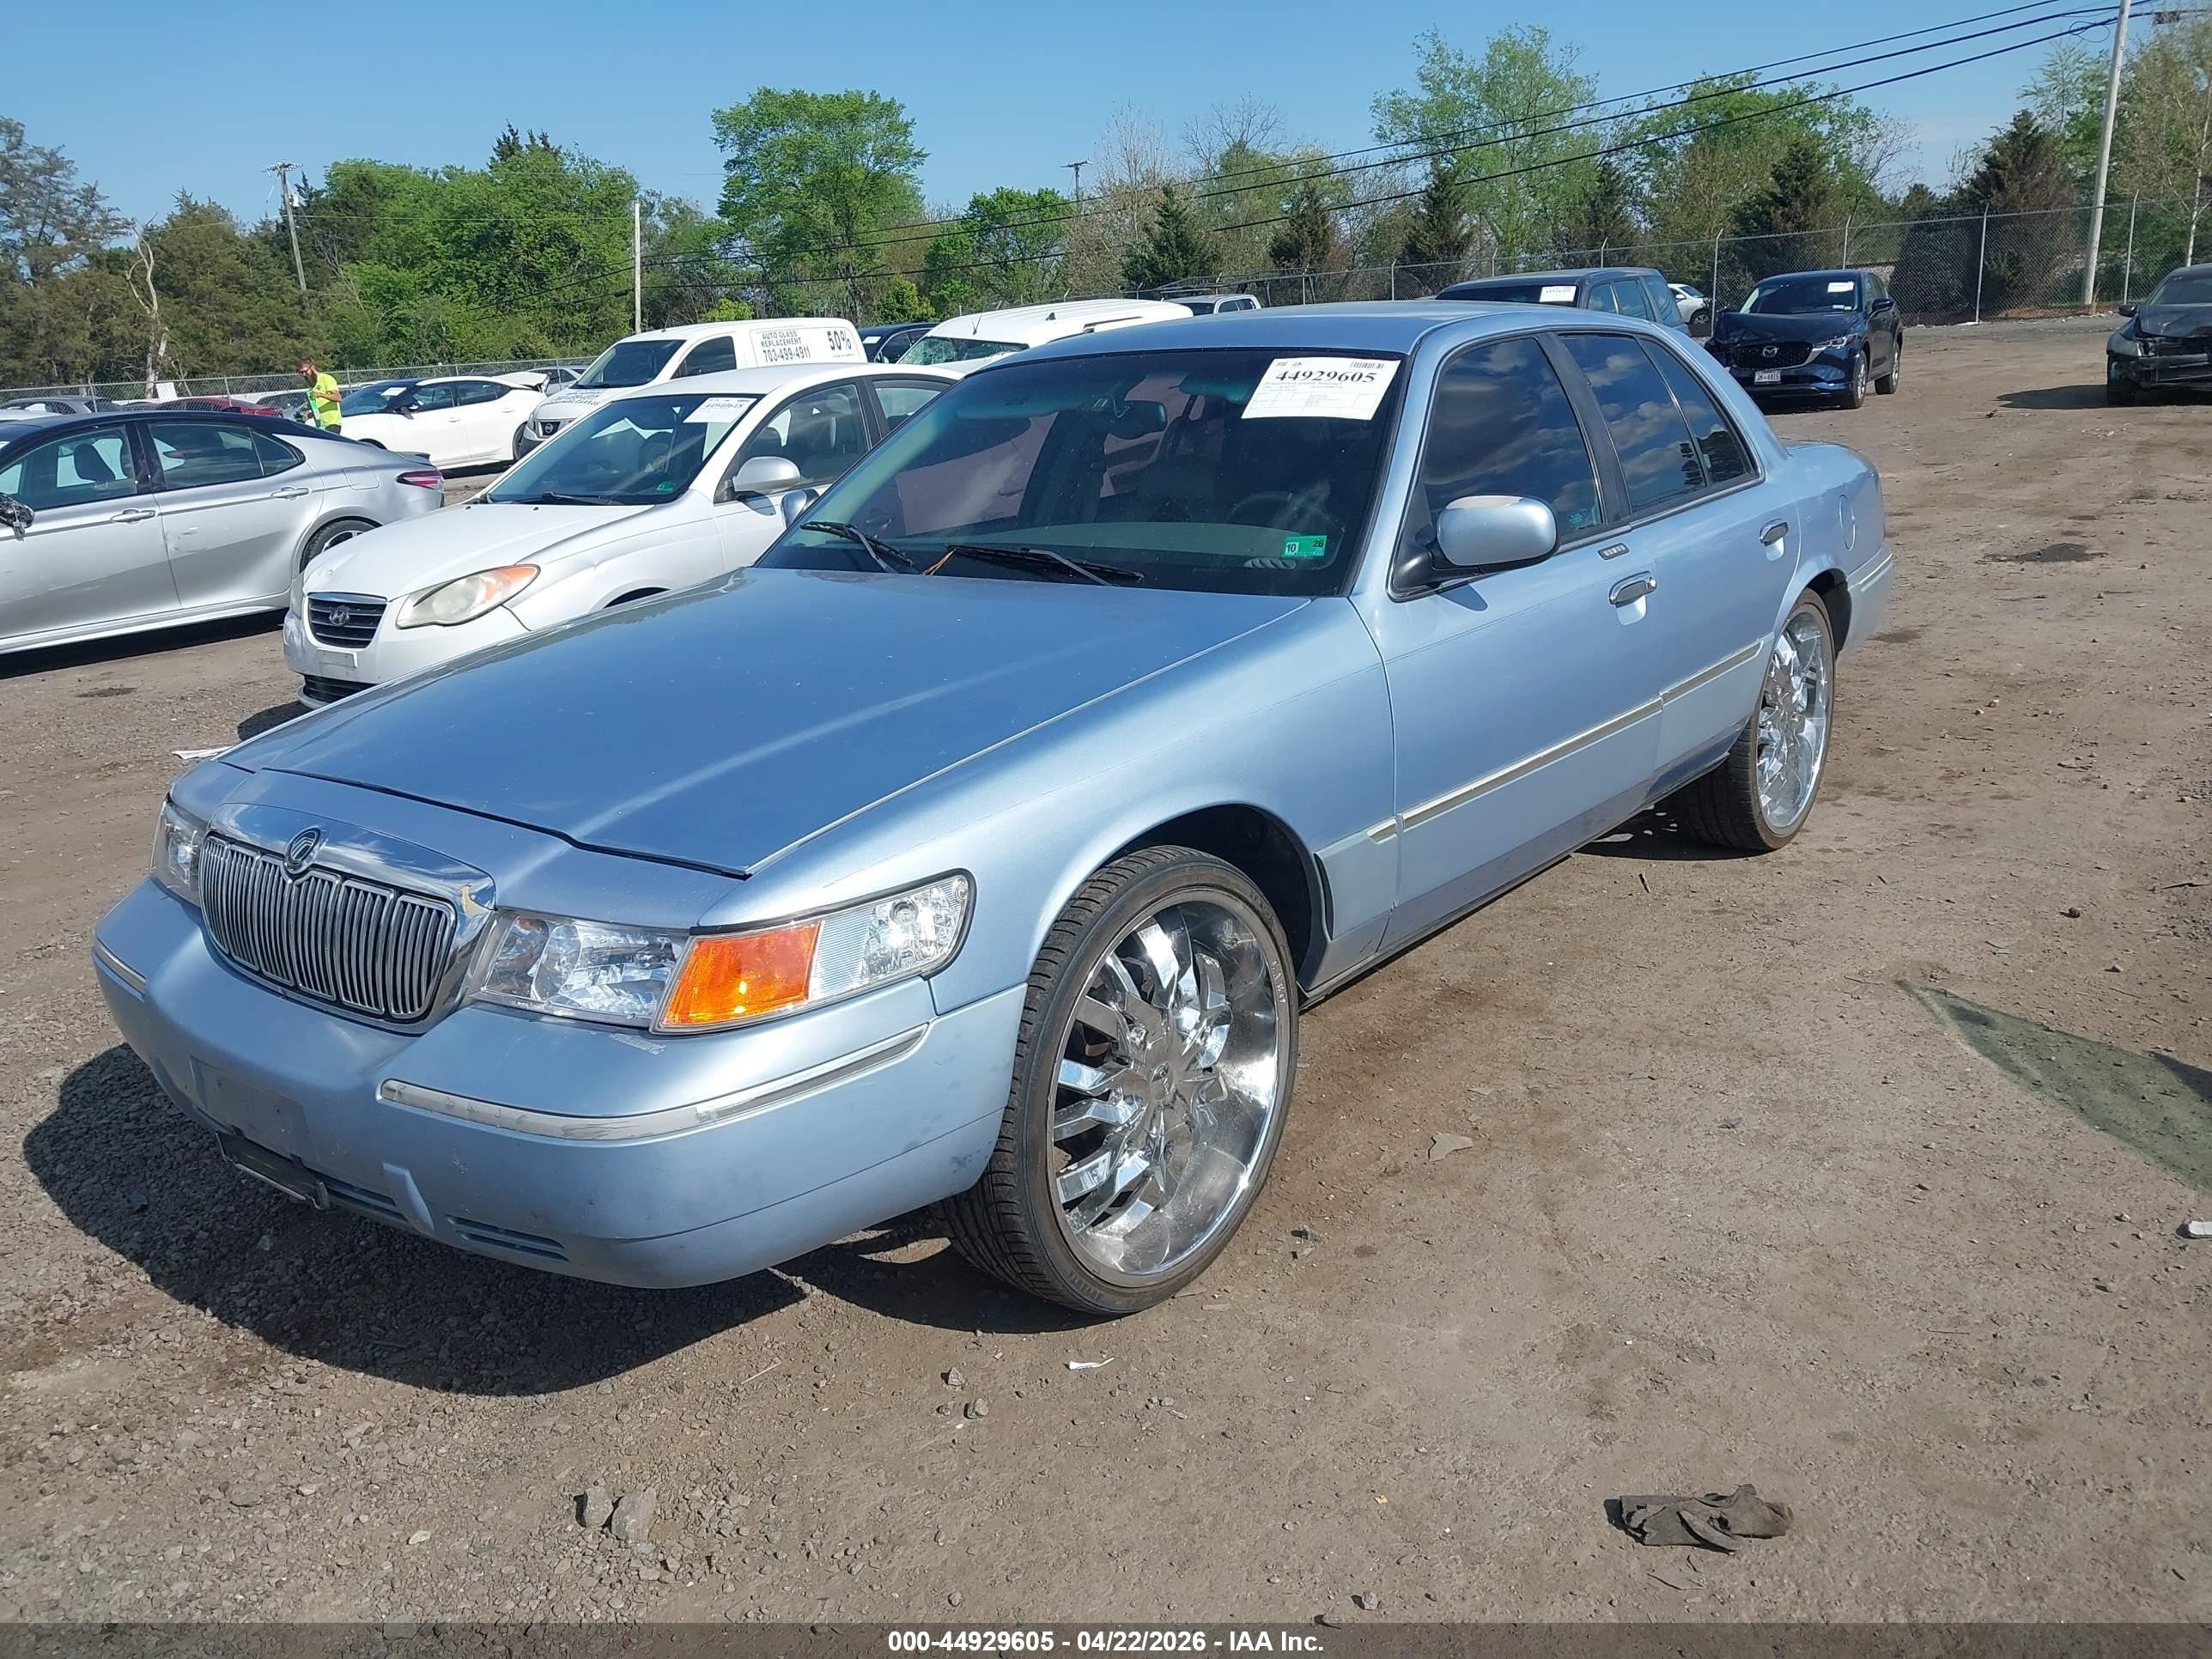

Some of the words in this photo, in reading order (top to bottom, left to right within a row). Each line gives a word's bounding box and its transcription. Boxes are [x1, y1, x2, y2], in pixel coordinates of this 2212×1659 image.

[760, 337, 802, 348] REPLACEMENT
[827, 329, 852, 350] 50%
[763, 345, 811, 362] 703-499-4911
[1275, 370, 1378, 383] 44929605
[1287, 543, 1297, 553] 10
